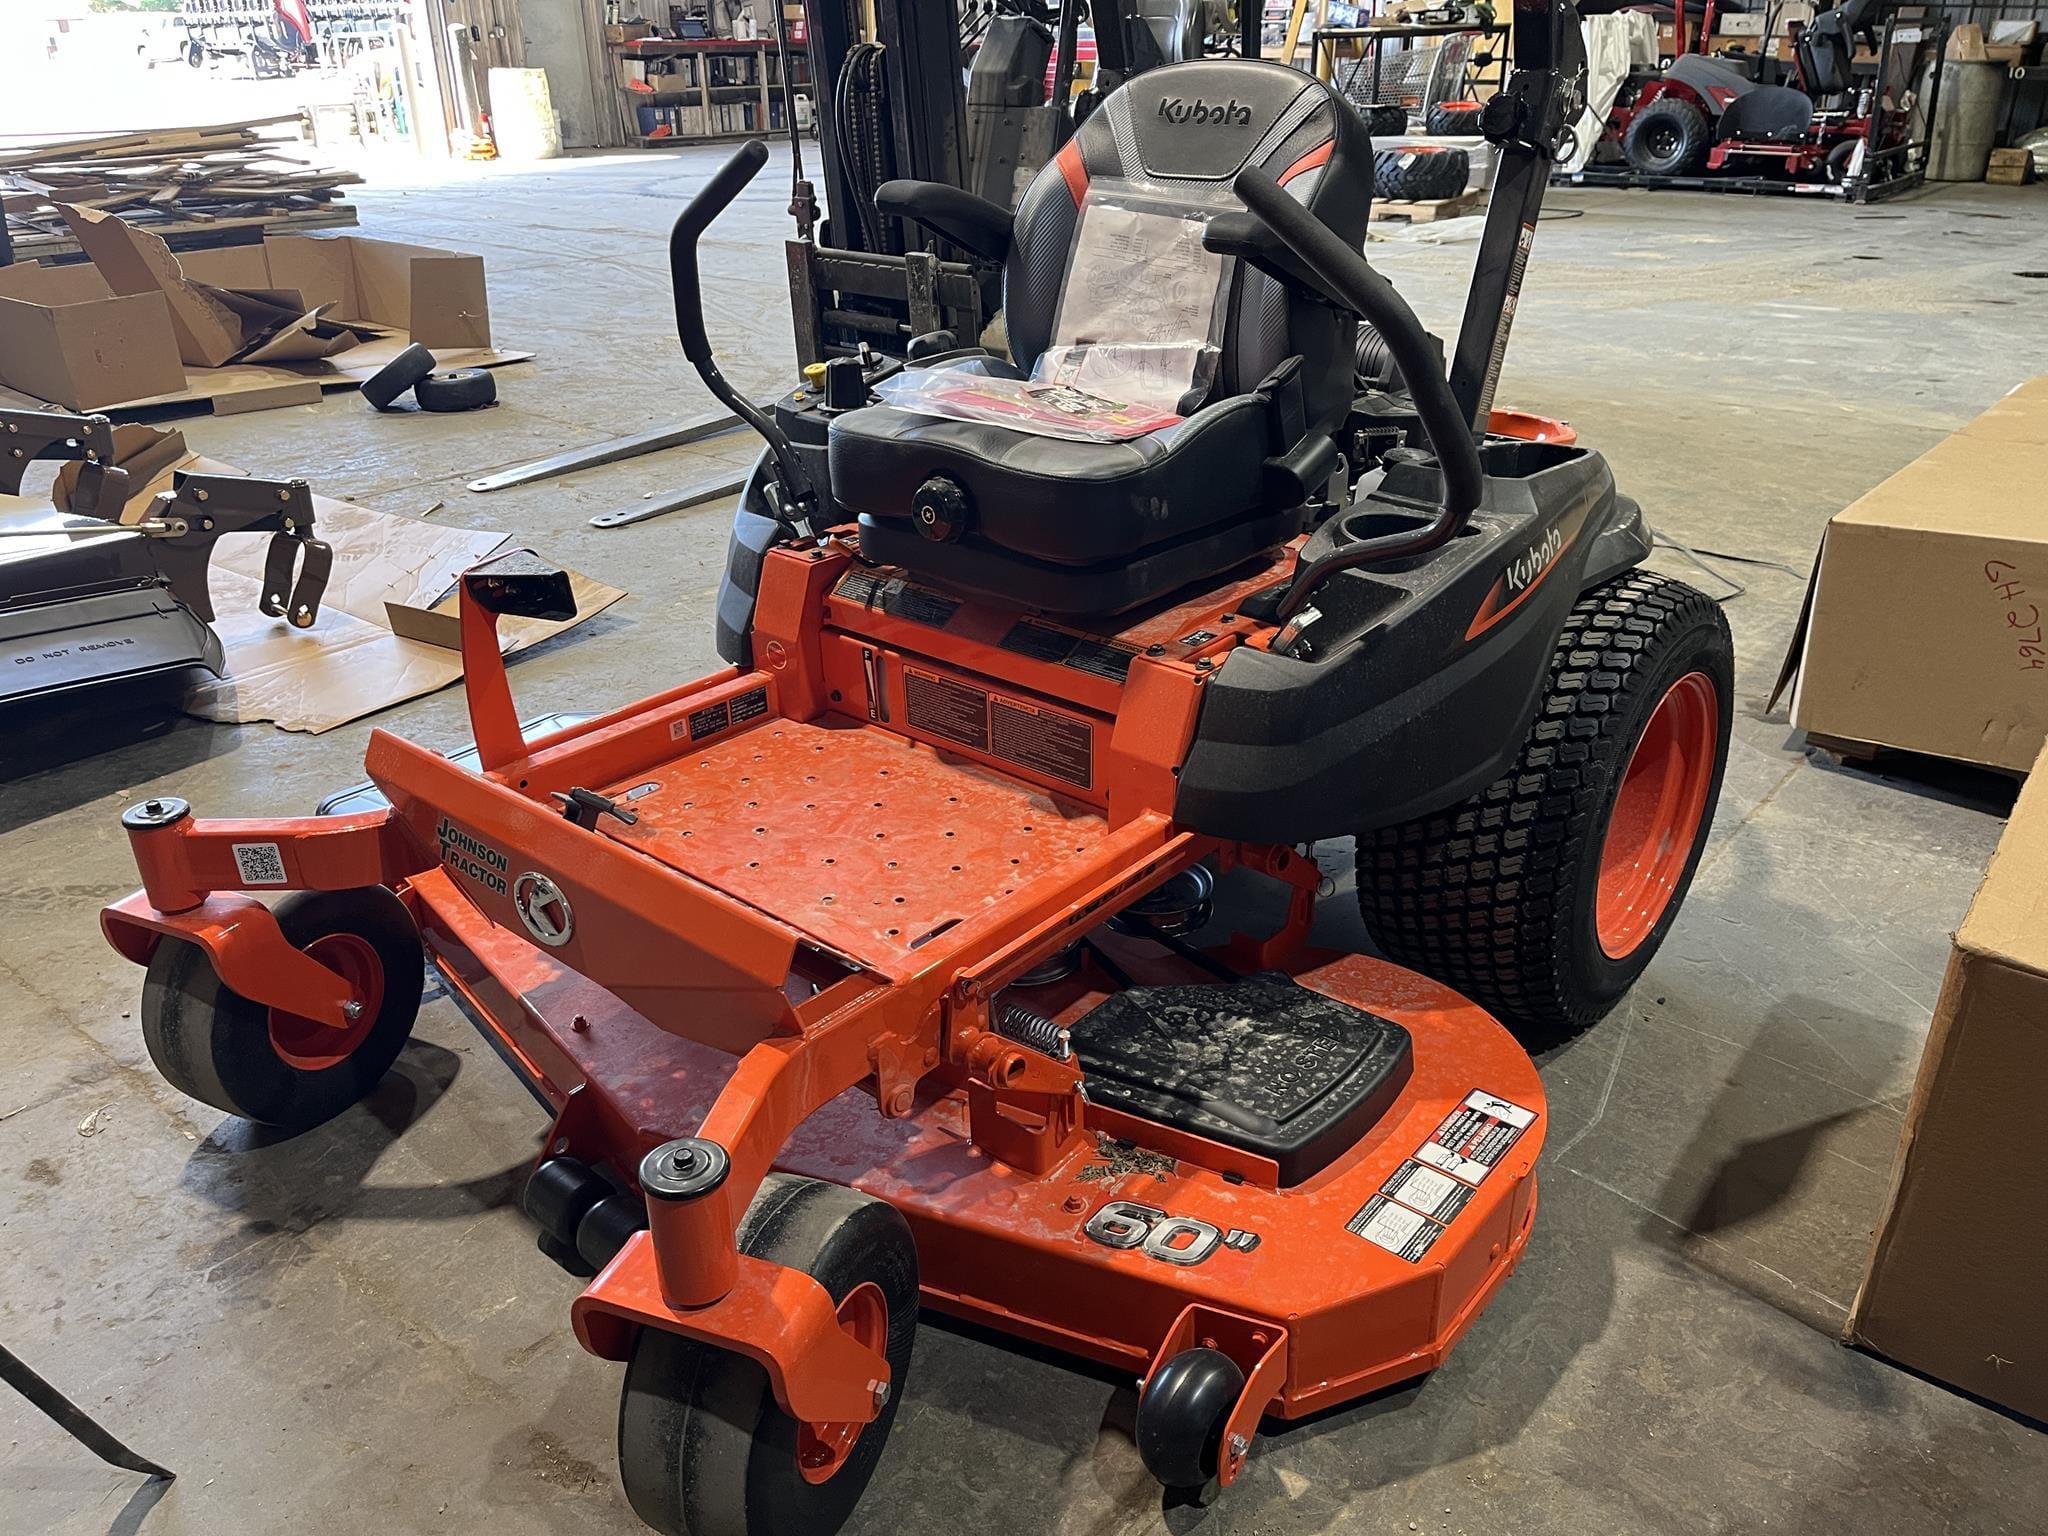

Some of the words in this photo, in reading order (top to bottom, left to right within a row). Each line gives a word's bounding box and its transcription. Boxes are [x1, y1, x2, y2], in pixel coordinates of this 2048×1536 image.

[2009, 66, 2025, 80] 10
[1158, 98, 1252, 125] Kubota
[1507, 528, 1562, 590] Kubota
[14, 657, 36, 665] DO
[42, 648, 71, 660] NOT
[78, 638, 135, 653] REMOVE
[864, 650, 870, 659] F
[870, 709, 876, 719] E
[436, 817, 508, 873] JOHNSON
[438, 838, 508, 897] TRACTOR
[1263, 1070, 1302, 1097] NO
[1294, 1028, 1342, 1071] STEP
[1440, 1110, 1464, 1132] DANGER
[1471, 1123, 1494, 1145] PELIGRO
